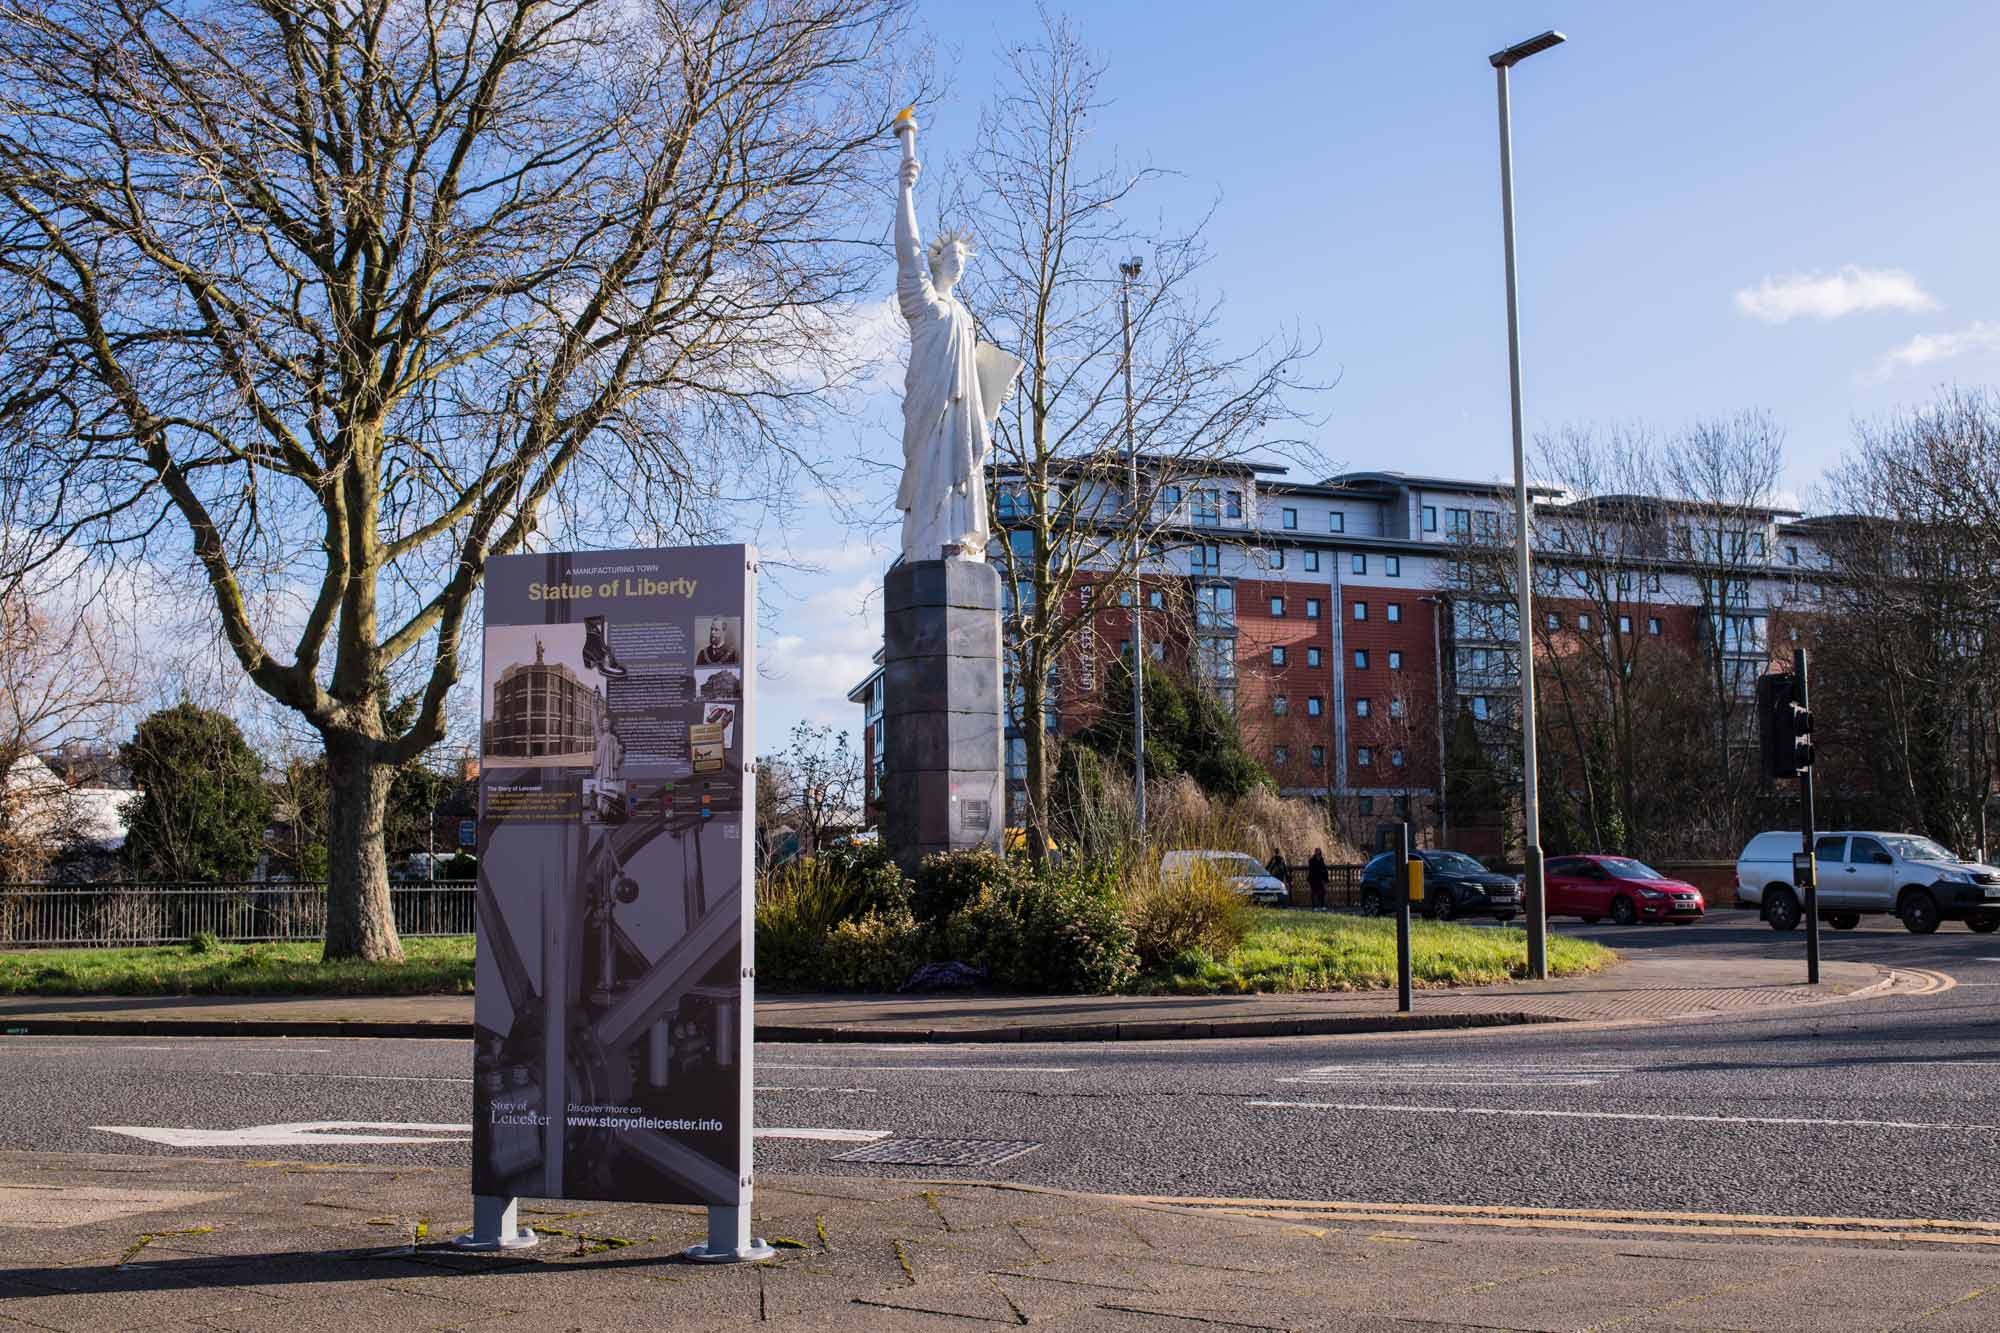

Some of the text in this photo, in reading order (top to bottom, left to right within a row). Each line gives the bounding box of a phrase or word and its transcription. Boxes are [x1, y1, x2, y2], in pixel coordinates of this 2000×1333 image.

[572, 566, 635, 575] MANUFACTURING
[636, 564, 659, 572] TOWN
[528, 577, 697, 601] Statue of Liberty
[490, 1099, 528, 1113] Story of
[567, 1103, 642, 1114] Discover more on
[490, 1110, 552, 1126] Leicester
[567, 1116, 723, 1132] www.storyofleicester.info
